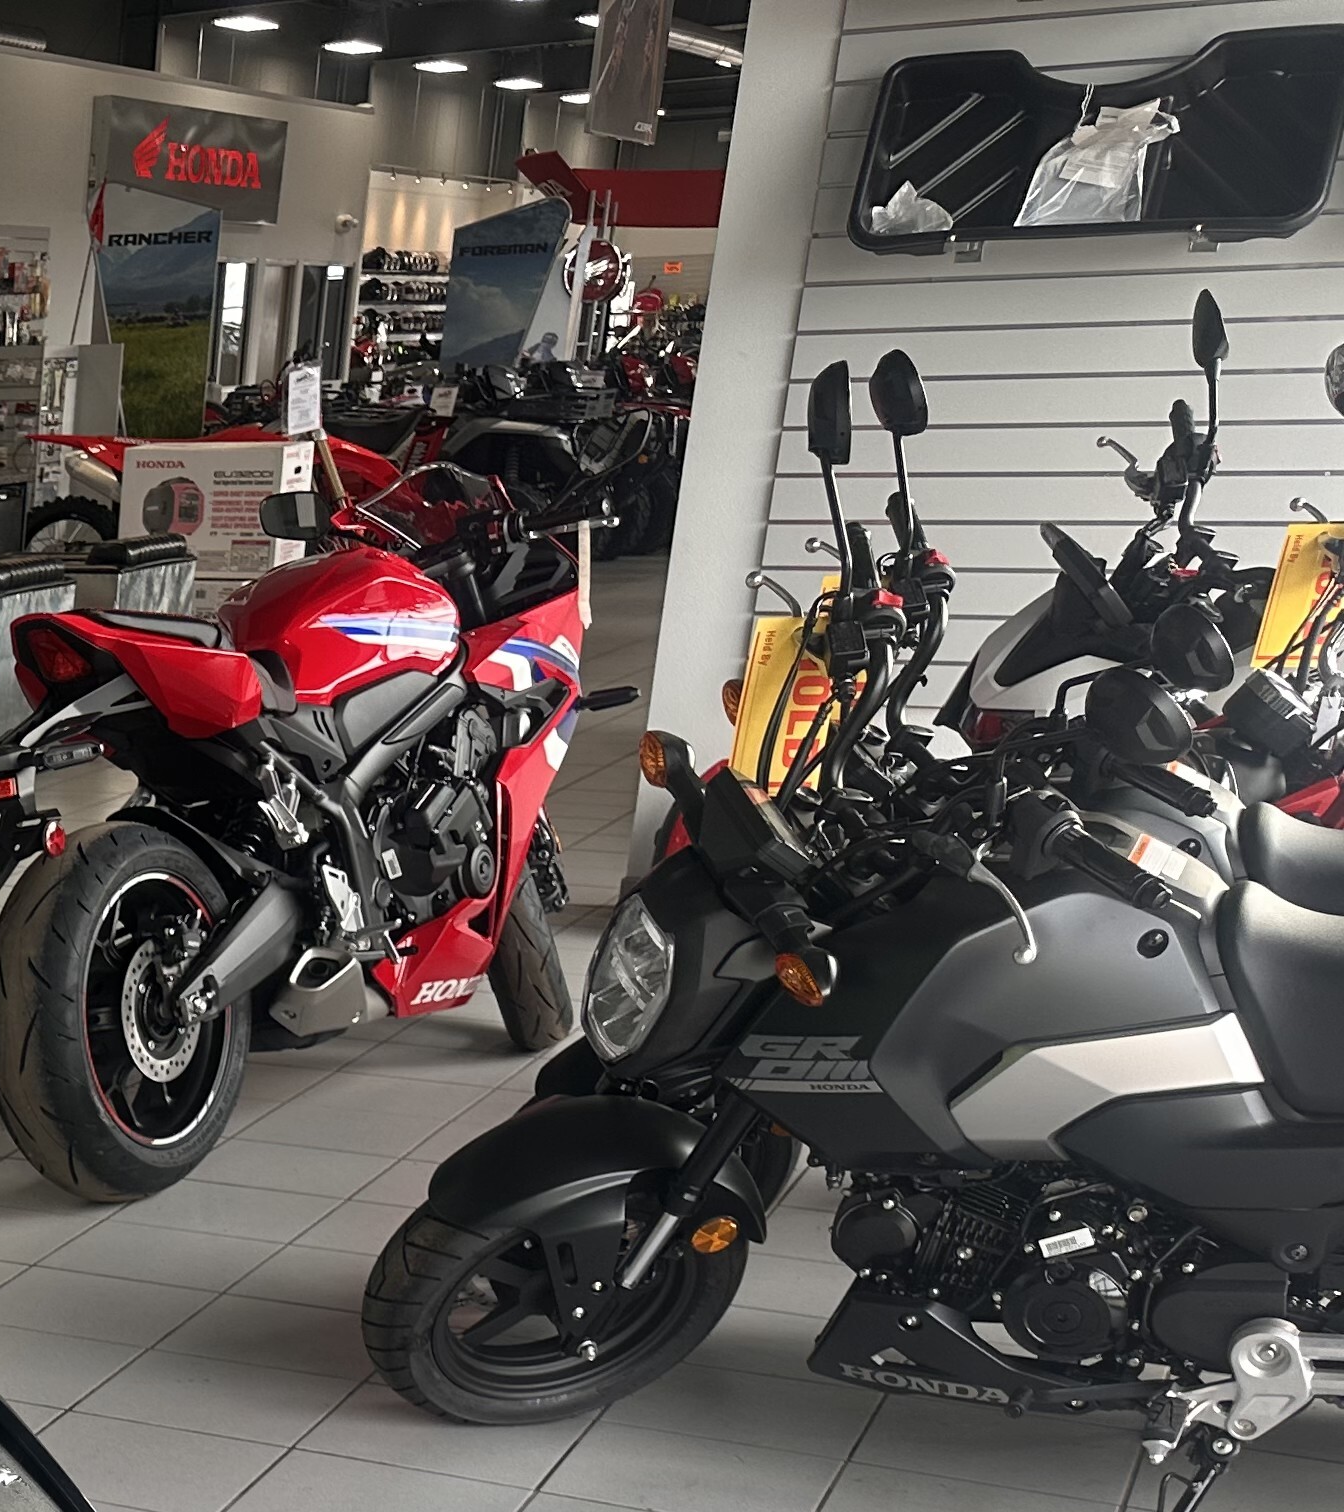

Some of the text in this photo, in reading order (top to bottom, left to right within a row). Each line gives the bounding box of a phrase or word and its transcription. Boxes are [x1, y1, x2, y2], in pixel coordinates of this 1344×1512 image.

[164, 142, 263, 189] HONDA
[108, 230, 214, 247] RANCHER
[459, 241, 549, 257] FOREMAN
[135, 459, 186, 470] HONDA
[409, 974, 485, 1006] HON
[810, 1082, 871, 1091] HONDA
[839, 1362, 1010, 1404] HONDA
